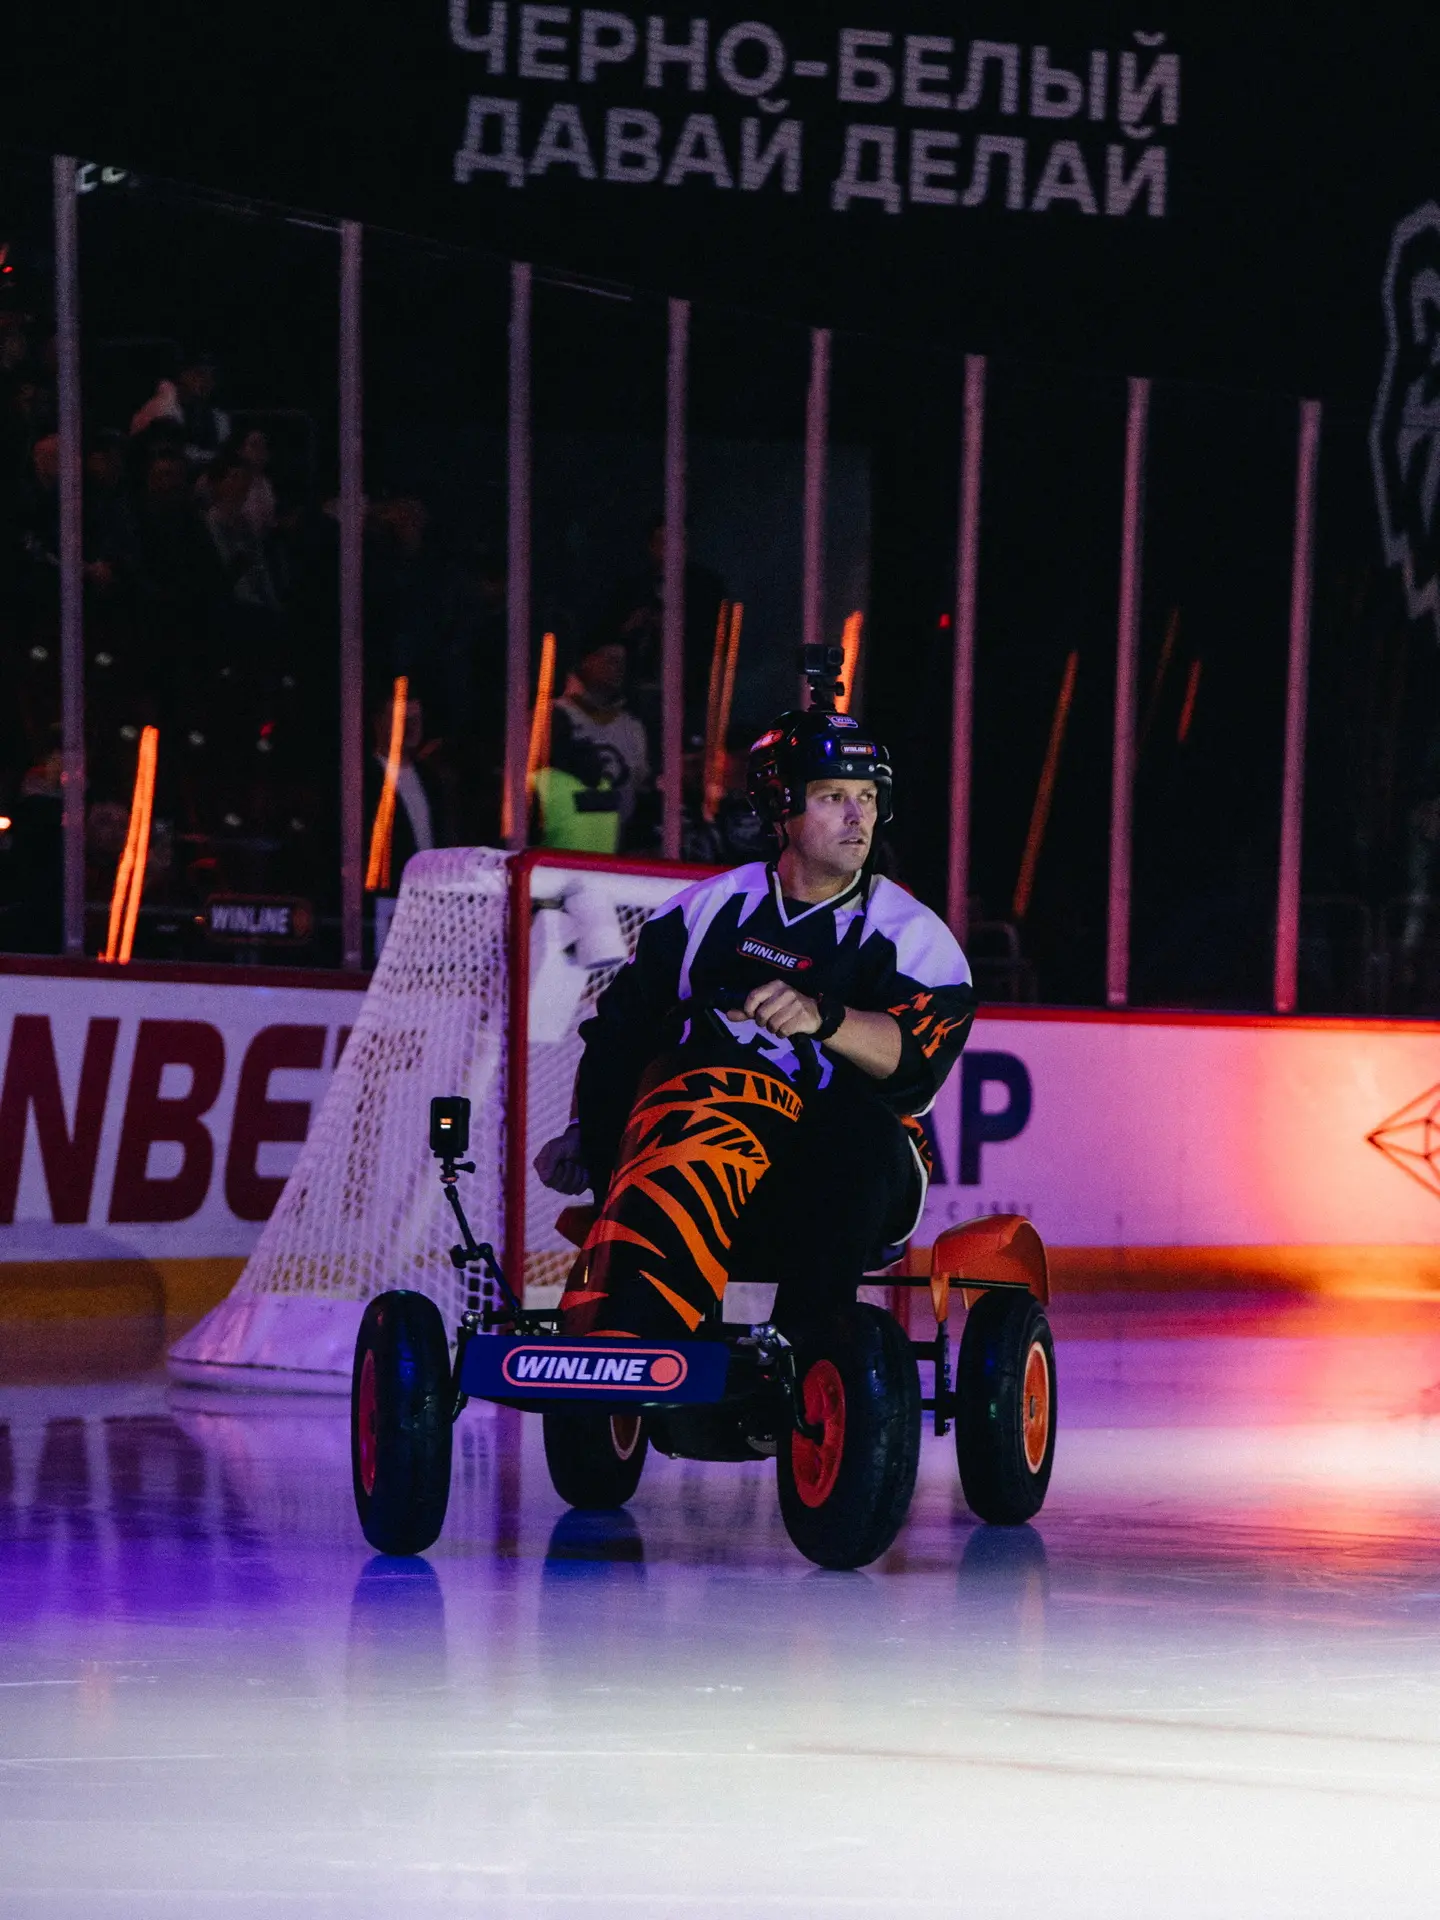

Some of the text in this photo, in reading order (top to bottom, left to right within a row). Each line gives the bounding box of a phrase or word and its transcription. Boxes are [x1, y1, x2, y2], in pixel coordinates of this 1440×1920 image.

[448, 0, 1181, 126] ЧЕРНО-БЕЛЫЙ
[453, 94, 1168, 219] ДАВАЙ ДЕЛАЙ
[212, 904, 291, 934] WINLINE
[742, 940, 798, 969] WINLINE
[0, 1014, 355, 1225] NBE
[516, 1355, 648, 1382] WINLINE
